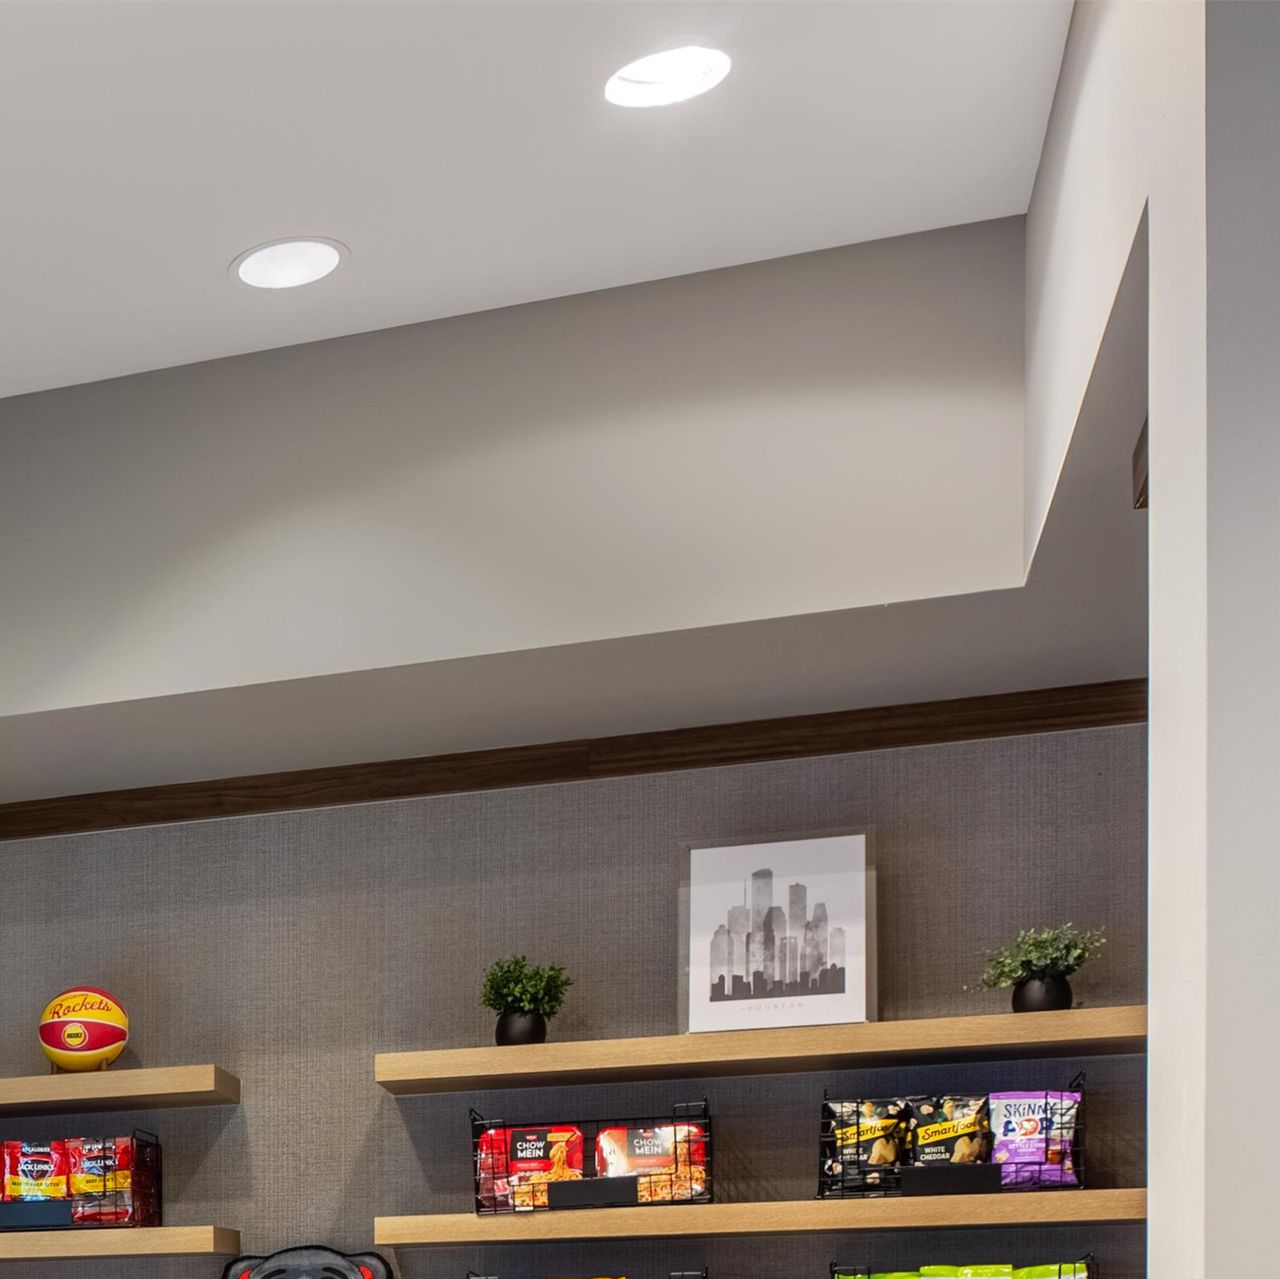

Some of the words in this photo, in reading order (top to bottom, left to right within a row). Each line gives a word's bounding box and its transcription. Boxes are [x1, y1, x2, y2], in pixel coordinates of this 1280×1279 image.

[50, 997, 112, 1019] Rockets
[516, 1141, 545, 1150] CHOW
[633, 1138, 662, 1147] CHOW
[517, 1149, 544, 1158] MEIN
[635, 1146, 661, 1155] MEIN
